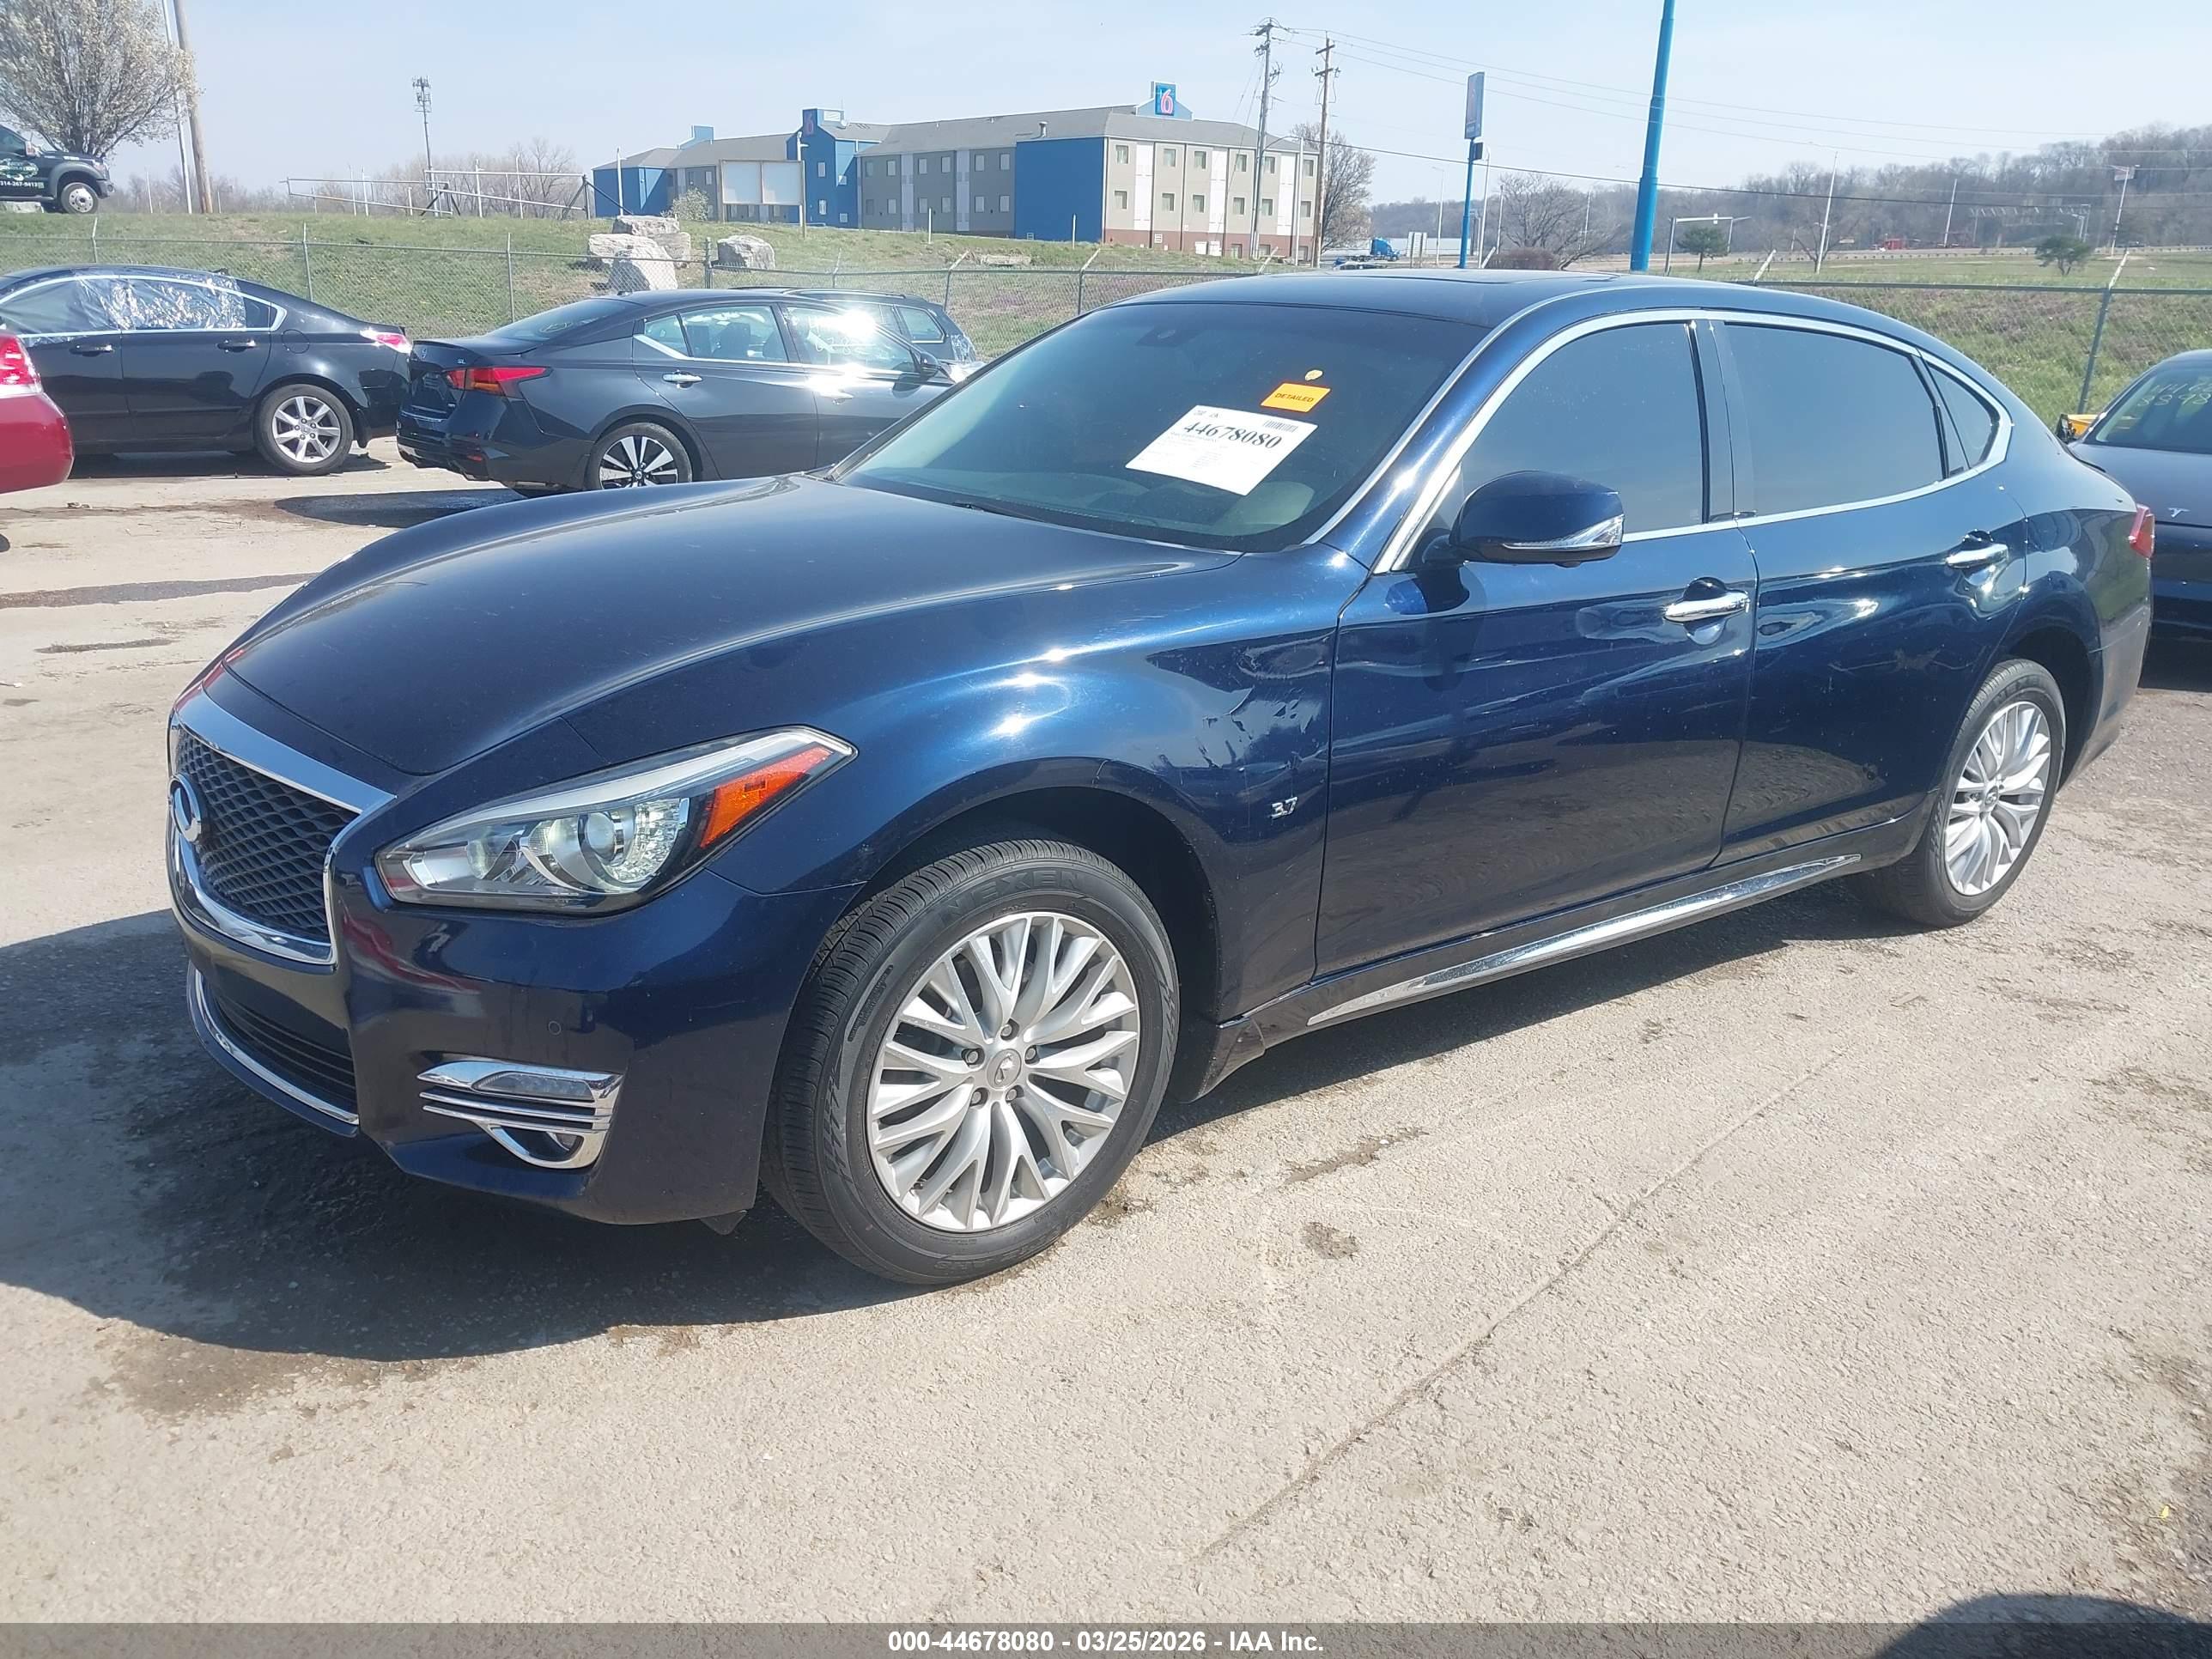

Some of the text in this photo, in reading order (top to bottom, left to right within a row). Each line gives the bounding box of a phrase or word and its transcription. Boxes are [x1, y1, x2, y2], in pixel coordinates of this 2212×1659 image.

[1161, 88, 1174, 114] 6
[1275, 392, 1314, 403] DETAILED
[1184, 422, 1282, 449] 44678080
